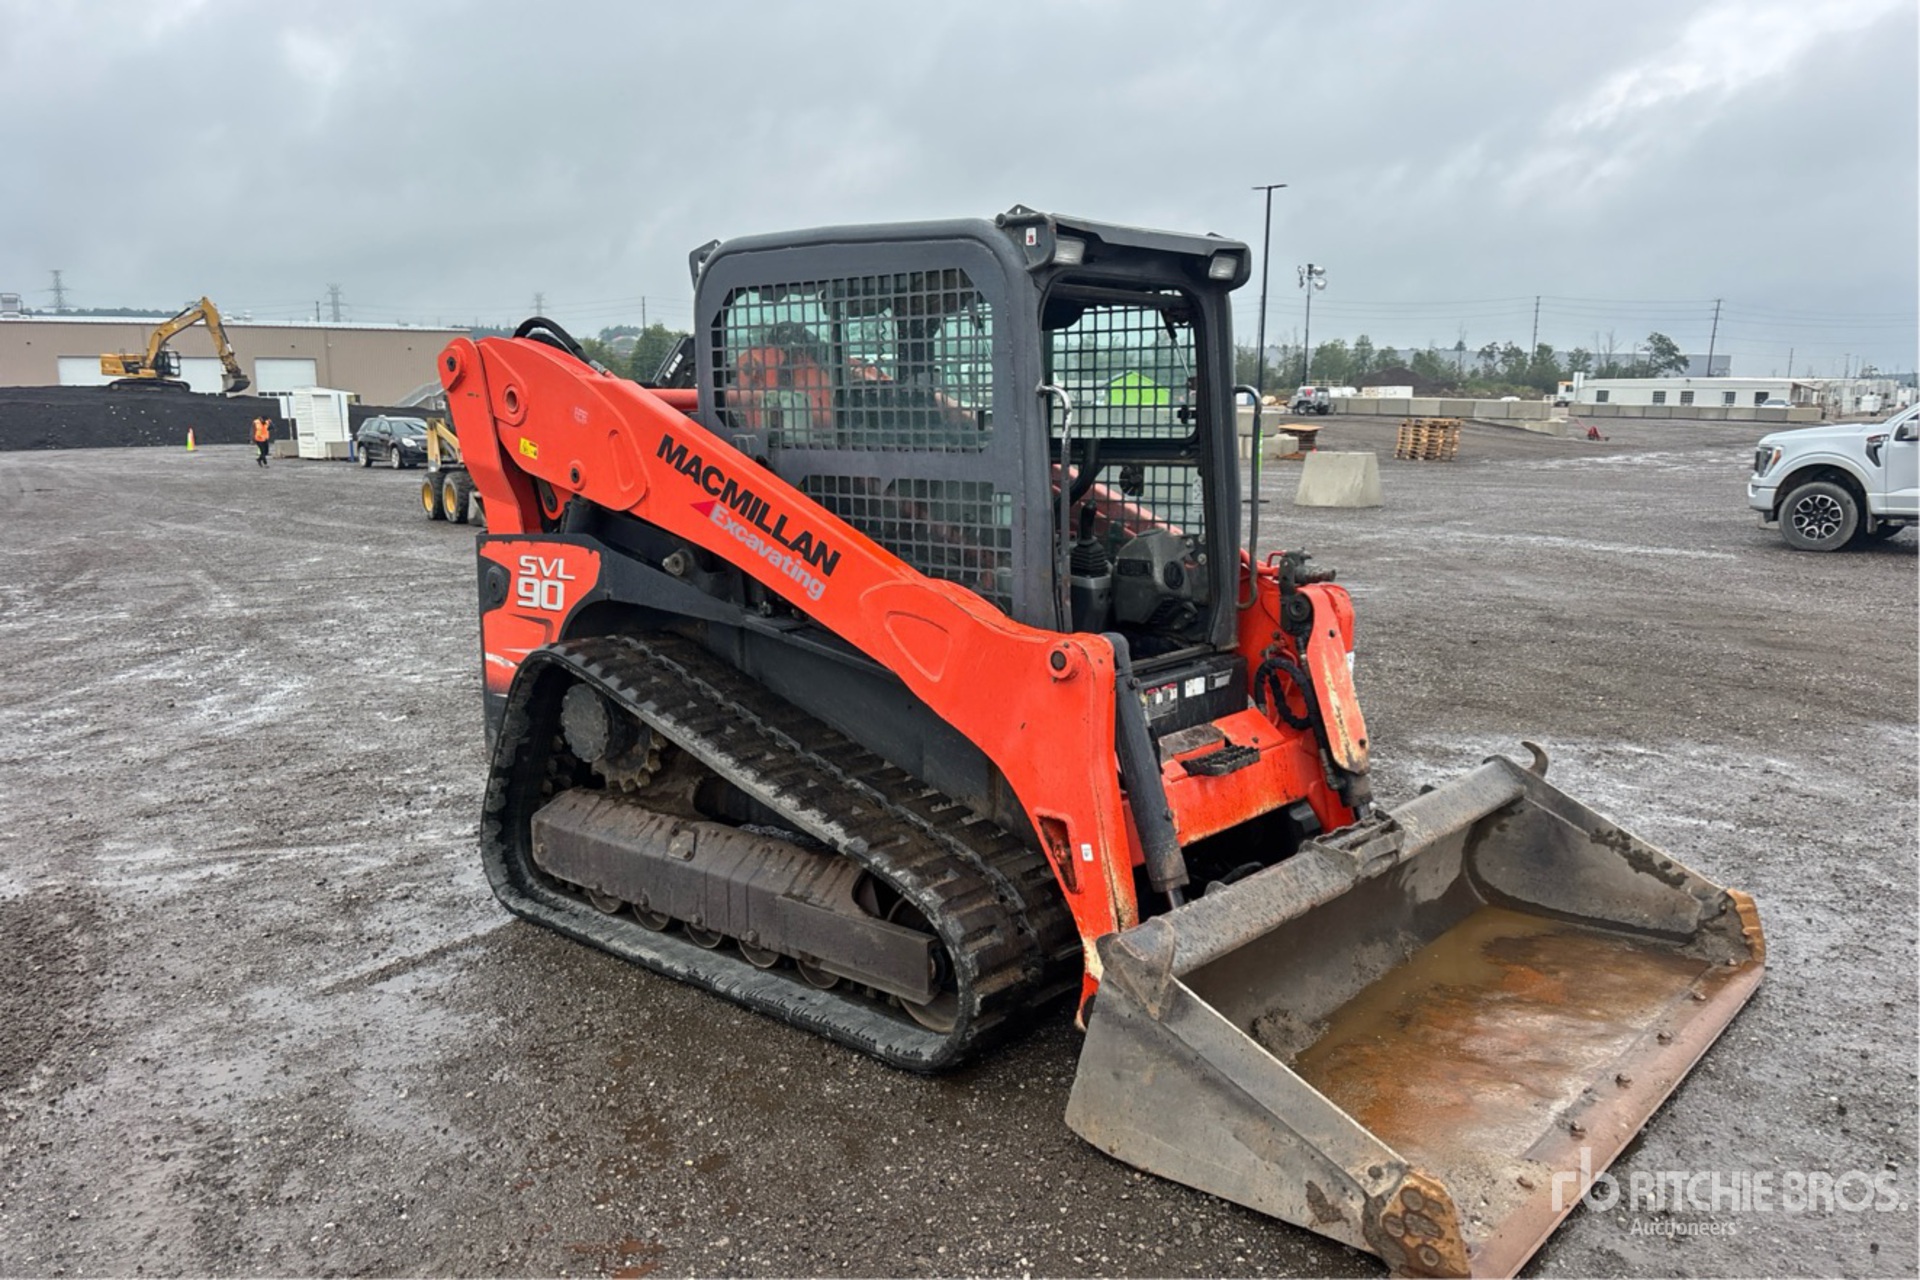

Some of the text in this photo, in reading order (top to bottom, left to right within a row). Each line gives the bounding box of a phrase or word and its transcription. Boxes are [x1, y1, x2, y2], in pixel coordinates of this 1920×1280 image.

[656, 433, 841, 578] MACMILLAN
[519, 554, 576, 580] SVL
[709, 503, 827, 601] Excavating
[517, 576, 565, 611] 90
